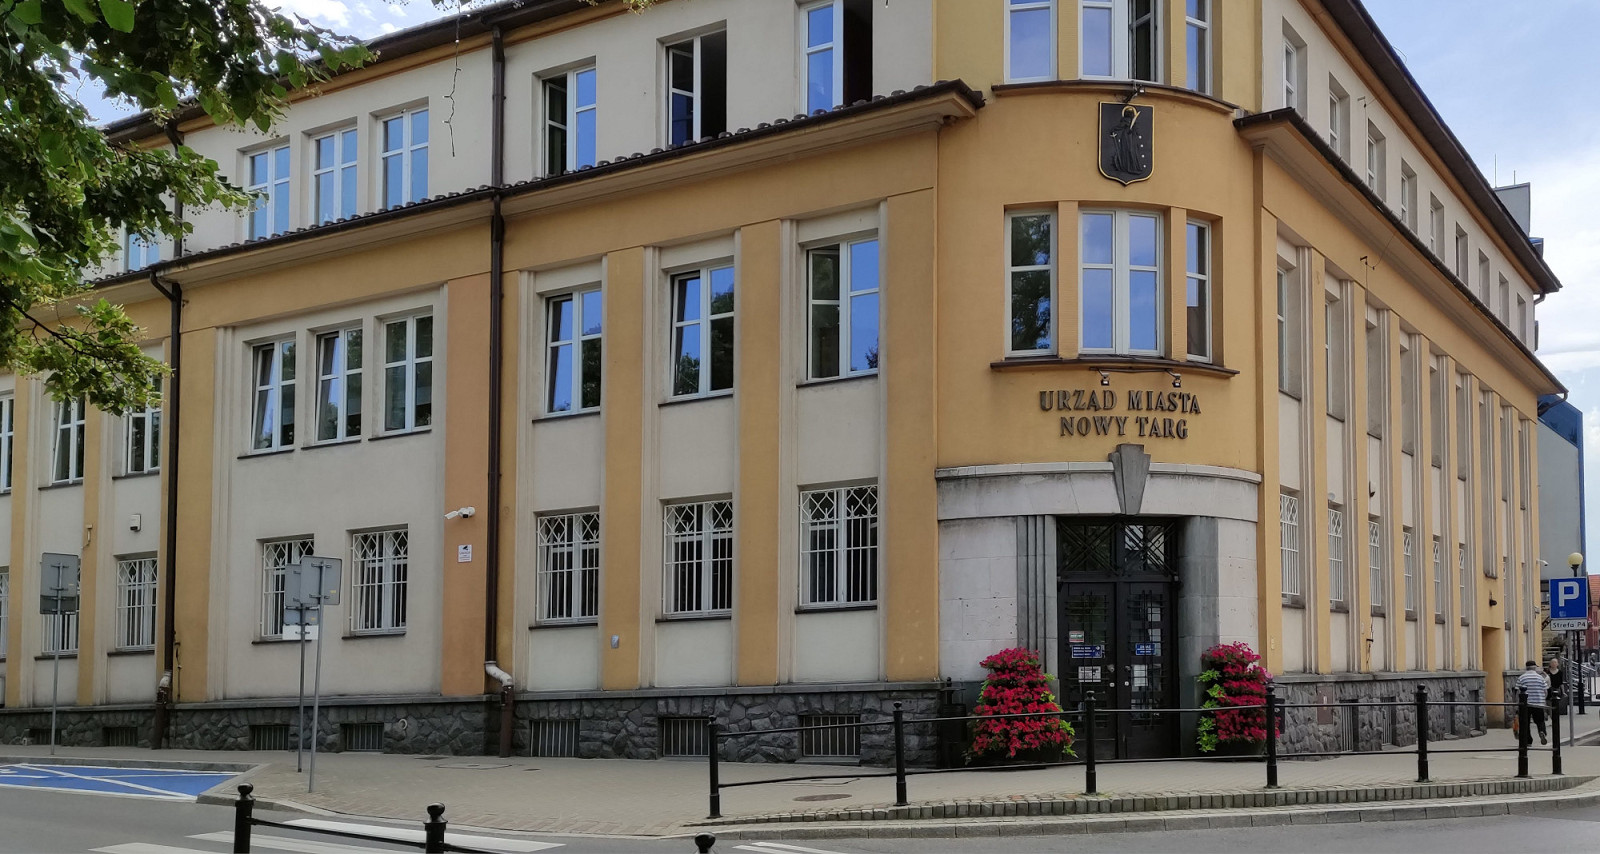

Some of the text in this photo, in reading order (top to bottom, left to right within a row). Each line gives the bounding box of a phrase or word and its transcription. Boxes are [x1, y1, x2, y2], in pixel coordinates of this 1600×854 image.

[1128, 389, 1201, 414] MIASTA
[1060, 415, 1188, 439] NOWY TARG
[1558, 581, 1580, 607] P
